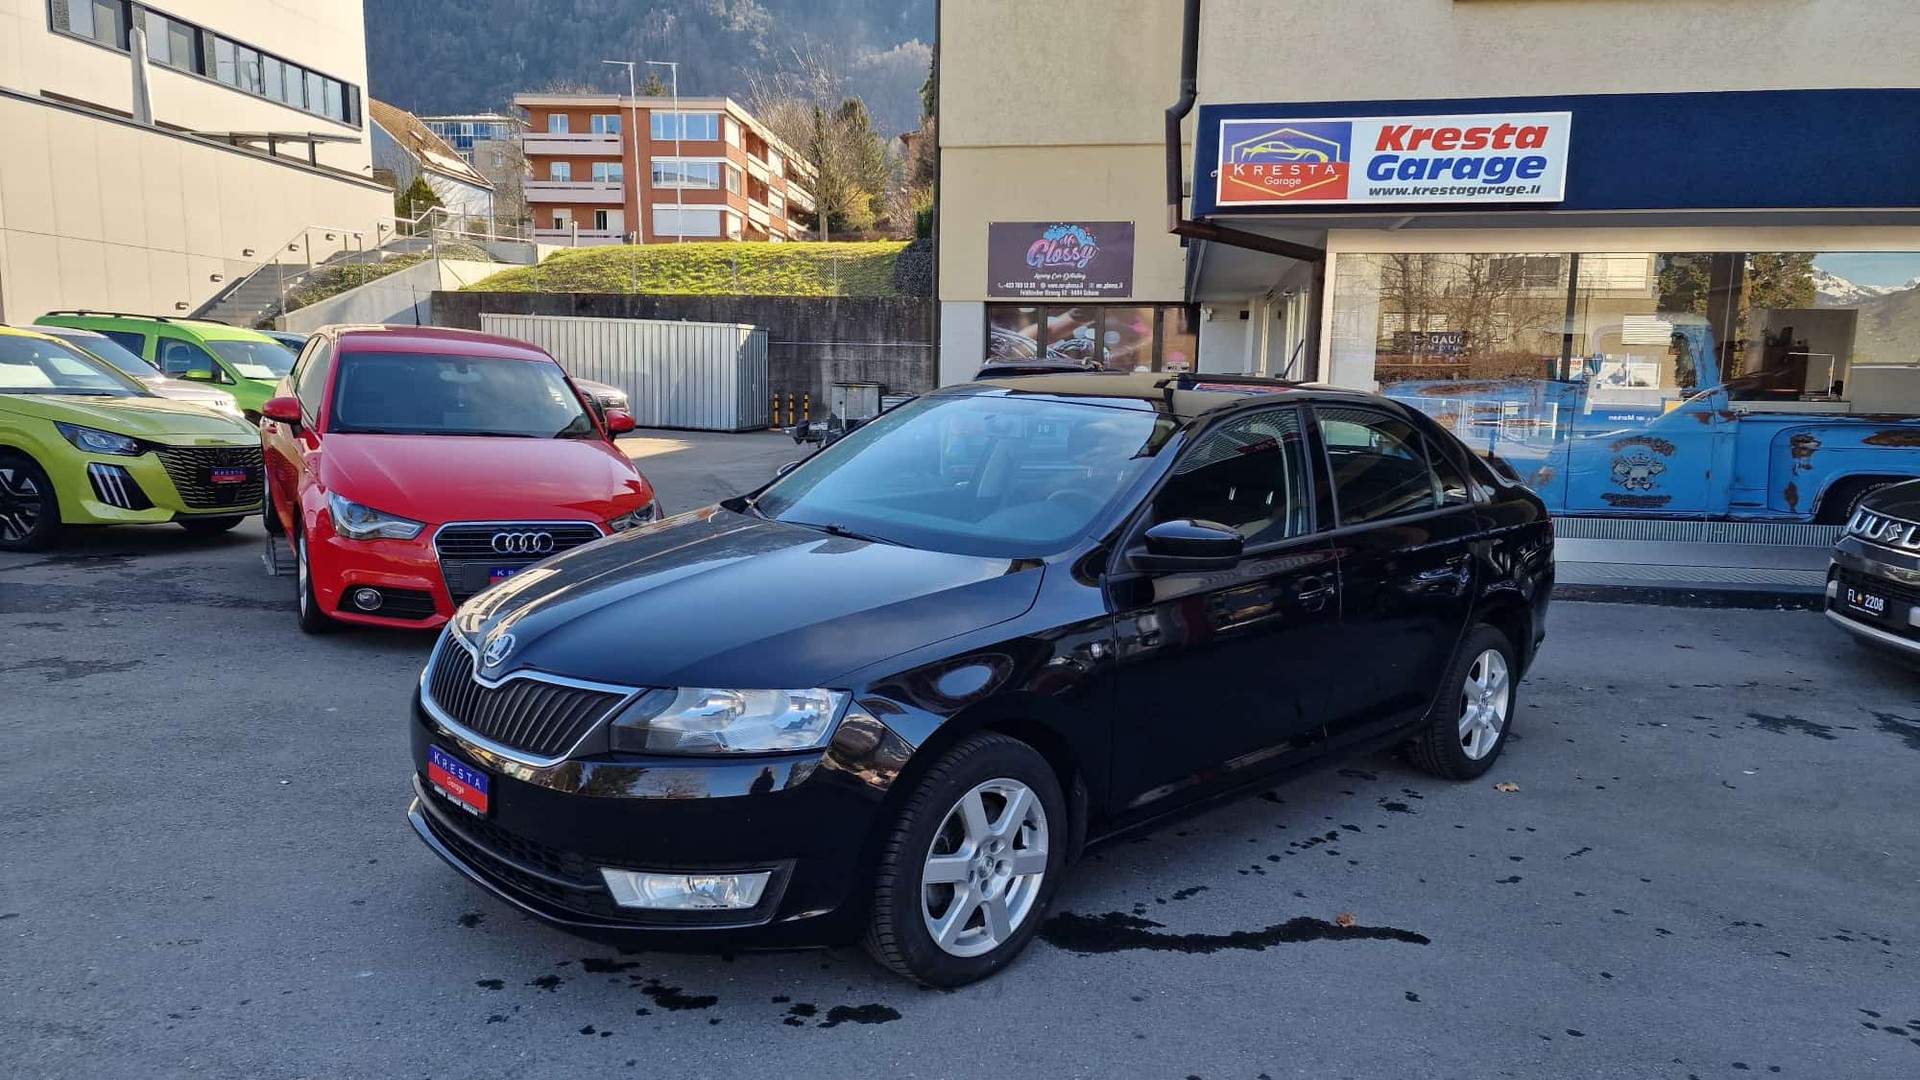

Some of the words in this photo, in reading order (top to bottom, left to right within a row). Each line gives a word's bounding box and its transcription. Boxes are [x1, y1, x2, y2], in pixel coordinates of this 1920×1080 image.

[1376, 123, 1548, 151] Kresta
[1233, 163, 1336, 176] KRESTA
[1366, 154, 1548, 184] Garage
[1264, 176, 1302, 187] Garage
[1368, 185, 1541, 198] www.krestagarage.li
[1026, 238, 1097, 269] Glossy
[1847, 588, 1857, 603] FL
[434, 751, 481, 789] KRESTA
